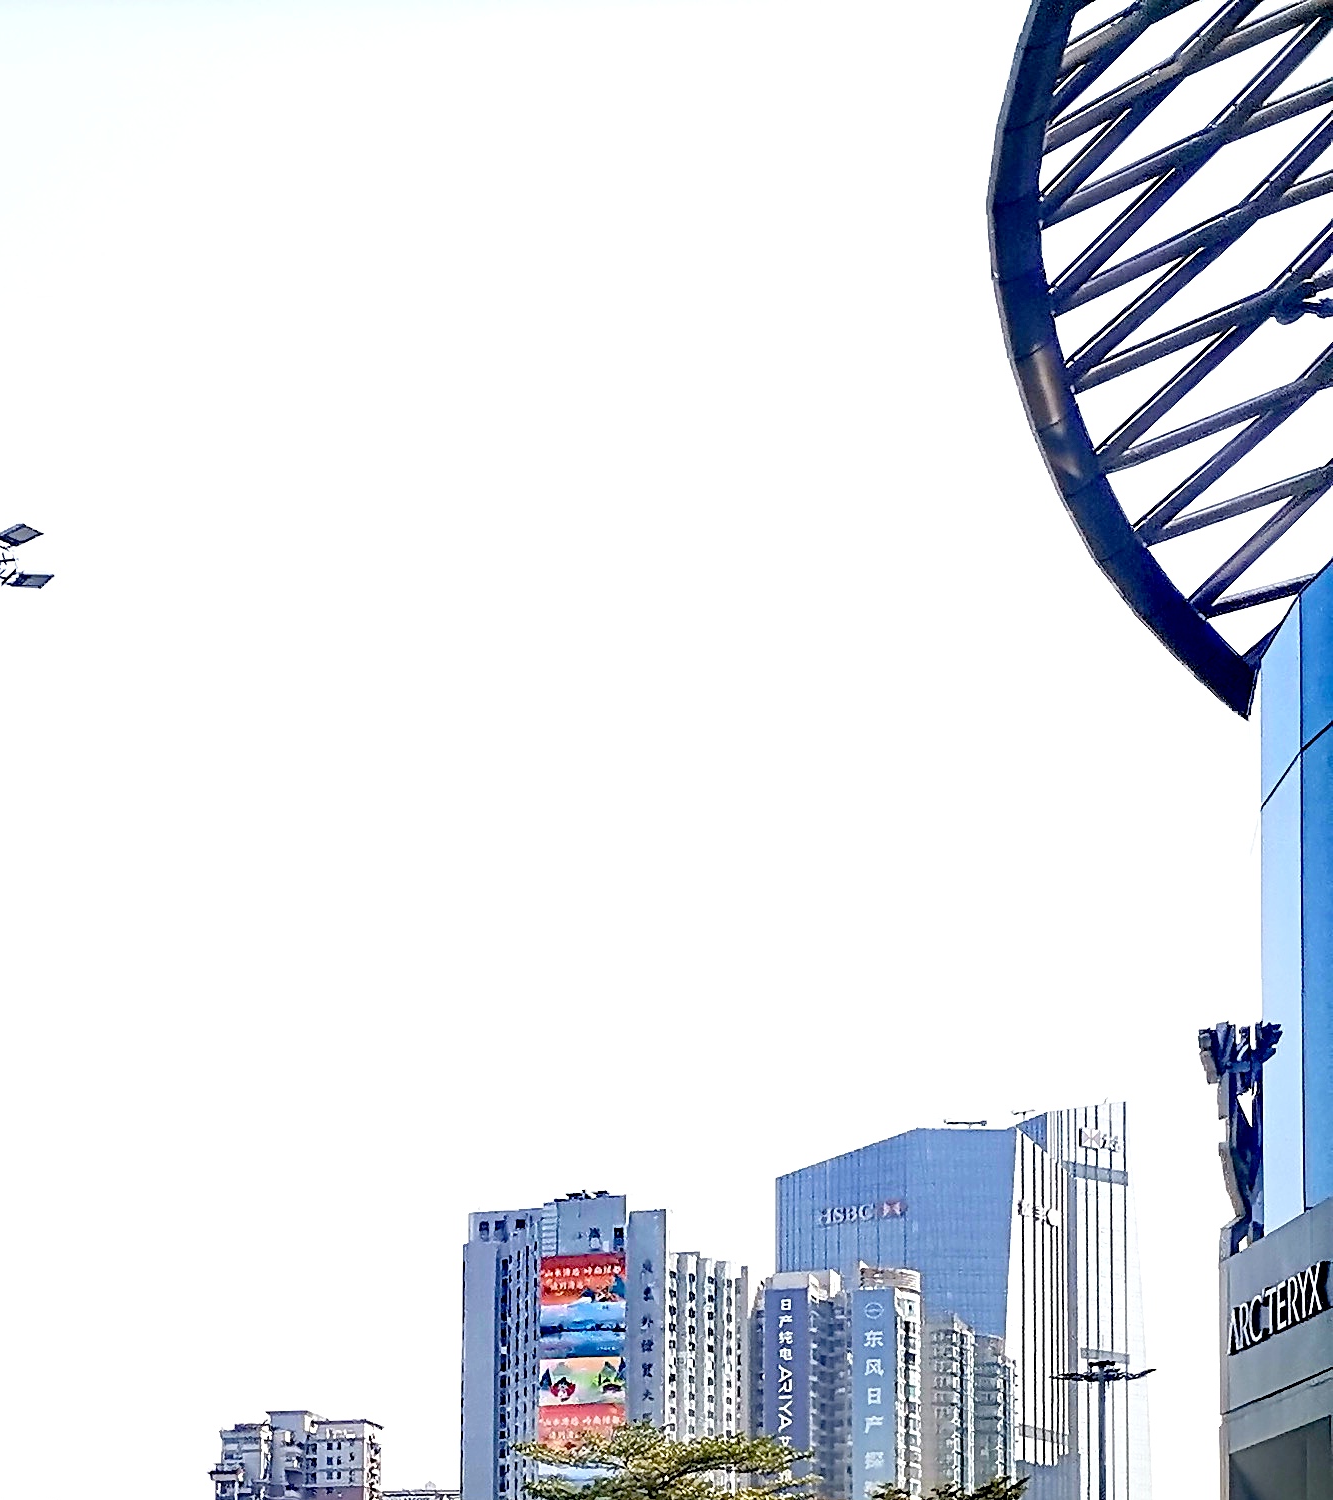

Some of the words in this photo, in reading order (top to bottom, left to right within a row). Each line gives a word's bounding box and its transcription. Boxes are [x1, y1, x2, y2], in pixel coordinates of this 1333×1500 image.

[820, 1203, 875, 1225] HSBC
[1227, 1261, 1323, 1356] ARC'TERYX
[777, 1365, 793, 1433] ARIYA
[863, 1329, 884, 1434] 东风日产
